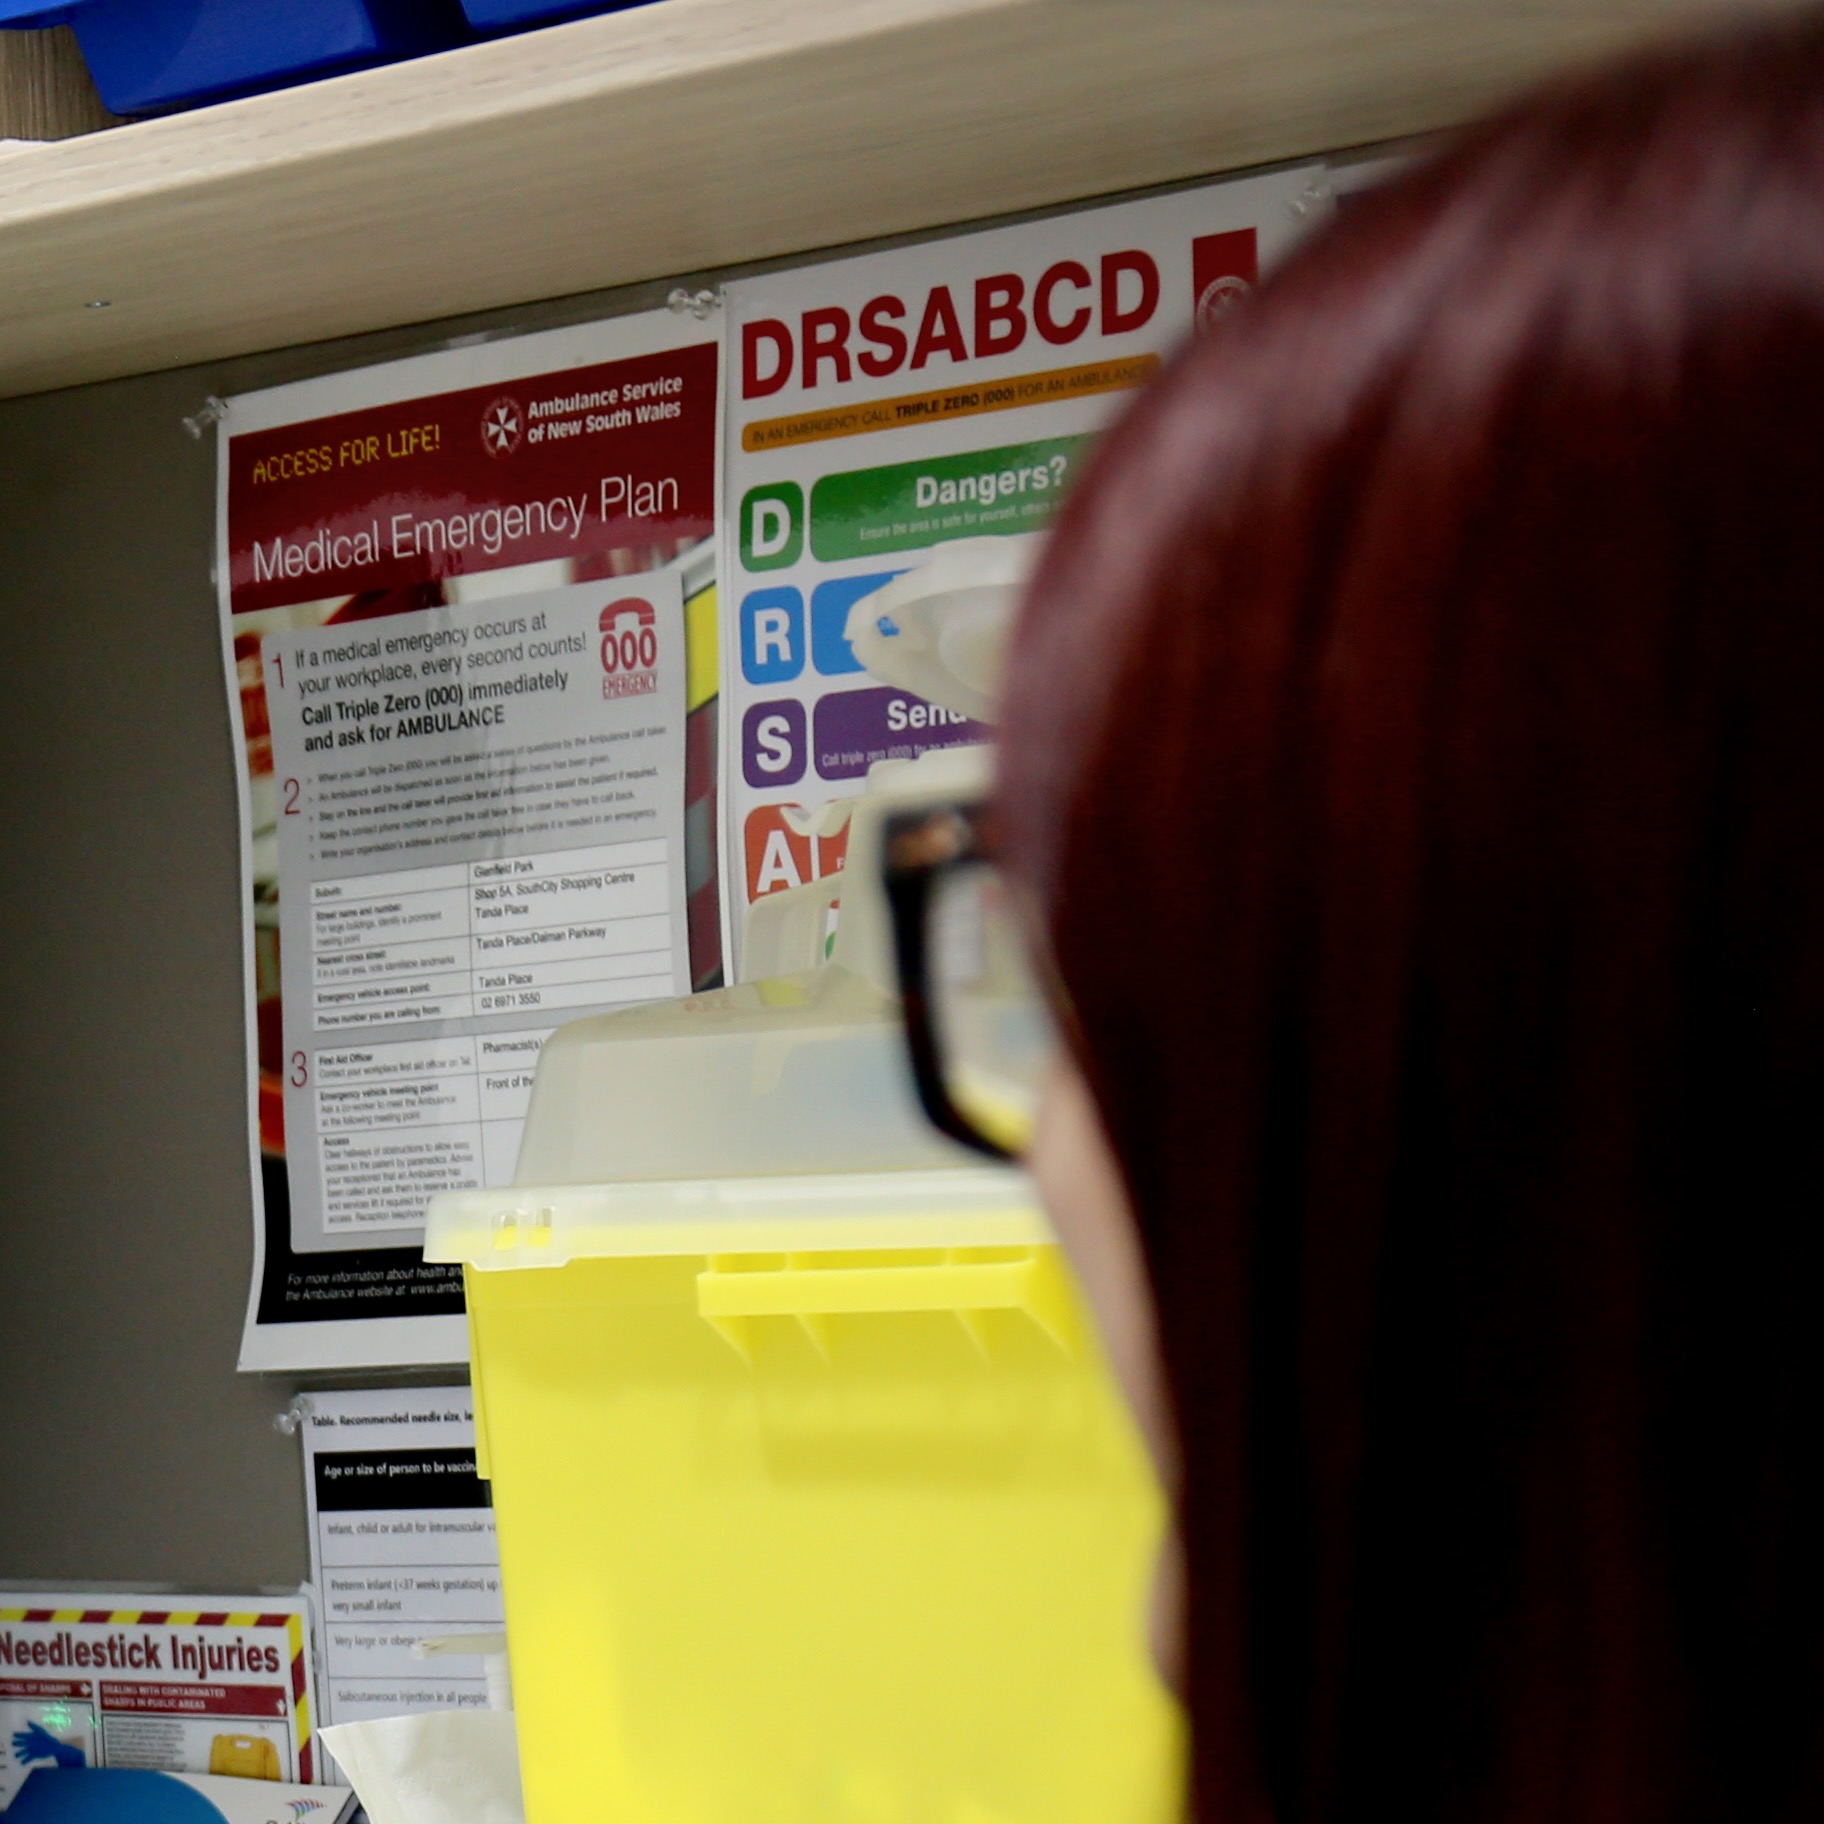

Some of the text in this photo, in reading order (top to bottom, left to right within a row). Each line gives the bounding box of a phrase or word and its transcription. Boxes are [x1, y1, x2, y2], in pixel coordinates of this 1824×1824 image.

[742, 248, 1162, 401] DRSABCD
[527, 375, 684, 421] Ambulance Service
[751, 428, 766, 444] IN
[768, 424, 784, 440] AN
[786, 413, 860, 439] EMERGENCY
[863, 407, 892, 426] CALL
[895, 398, 941, 421] TRIPLE
[943, 392, 980, 413] ZERO
[983, 386, 1016, 408] (000)
[1018, 381, 1044, 399] FOR
[1046, 378, 1066, 394] AN
[527, 400, 682, 445] of New South Wales
[252, 423, 441, 485] ACCESS FOR LIFE!
[916, 454, 1068, 509] Dangers?
[252, 472, 679, 583] Medical Emergency Plan
[752, 498, 791, 558] D
[295, 611, 548, 669] If a medical emergency occurs at
[600, 626, 658, 674] 000
[753, 606, 792, 666] R
[272, 652, 285, 689] 1
[297, 632, 588, 700] your workplace, every second counts!
[302, 669, 569, 726] Call Triple Zero (000) immediately
[304, 704, 506, 752] and ask for AMBULANCE
[755, 714, 793, 773] S
[283, 777, 301, 816] 2
[514, 861, 534, 875] Park
[756, 829, 802, 894] A
[474, 888, 498, 902] Shop
[561, 875, 603, 894] Shopping
[604, 871, 636, 885] Centre
[475, 902, 529, 920] Tanda Place
[476, 936, 504, 951] Tanda
[568, 926, 606, 944] Parkway
[479, 972, 533, 989] Tanda Place
[481, 997, 492, 1009] 02
[519, 992, 541, 1005] 3550
[291, 1051, 308, 1088] 3
[486, 1077, 509, 1090] Front
[511, 1075, 520, 1088] of
[340, 1412, 410, 1425] Recommended
[411, 1411, 441, 1423] needle
[443, 1412, 462, 1423] size,
[324, 1465, 343, 1479] Age
[344, 1466, 354, 1475] or
[356, 1464, 375, 1475] size
[377, 1462, 387, 1475] of
[389, 1464, 420, 1478] person
[423, 1463, 432, 1473] to
[434, 1461, 445, 1472] be
[331, 1579, 364, 1591] Preterm
[367, 1579, 392, 1590] infant
[416, 1578, 440, 1590] weeks
[443, 1578, 484, 1593] gestation)
[486, 1580, 498, 1592] up
[170, 1633, 280, 1679] Injuries
